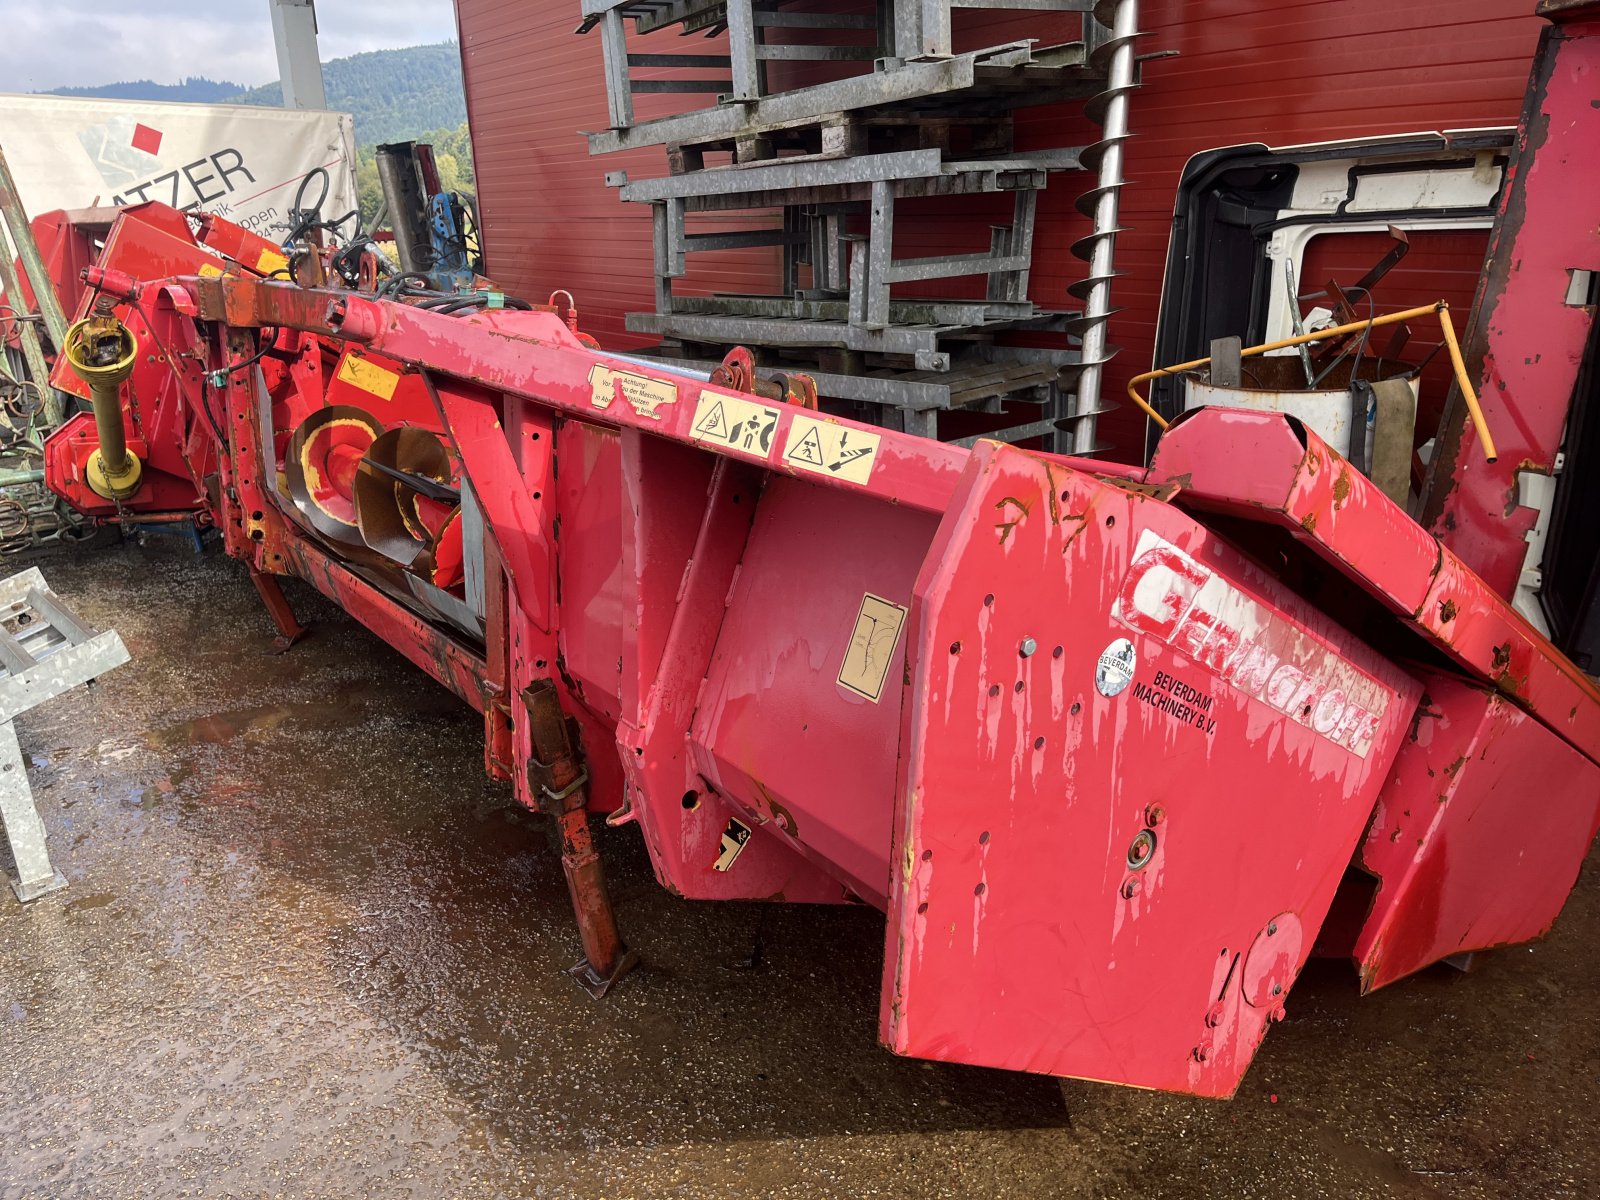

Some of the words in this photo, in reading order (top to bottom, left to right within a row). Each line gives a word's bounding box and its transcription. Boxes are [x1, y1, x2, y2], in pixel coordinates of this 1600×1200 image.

[602, 379, 611, 387] Vor
[623, 378, 648, 389] Achtung!
[639, 390, 665, 402] Maschine
[1099, 655, 1133, 678] BEVERDAM
[1154, 671, 1213, 712] BEVERDAM
[1132, 682, 1198, 724] MACHINERY
[1195, 714, 1216, 735] B.V.
